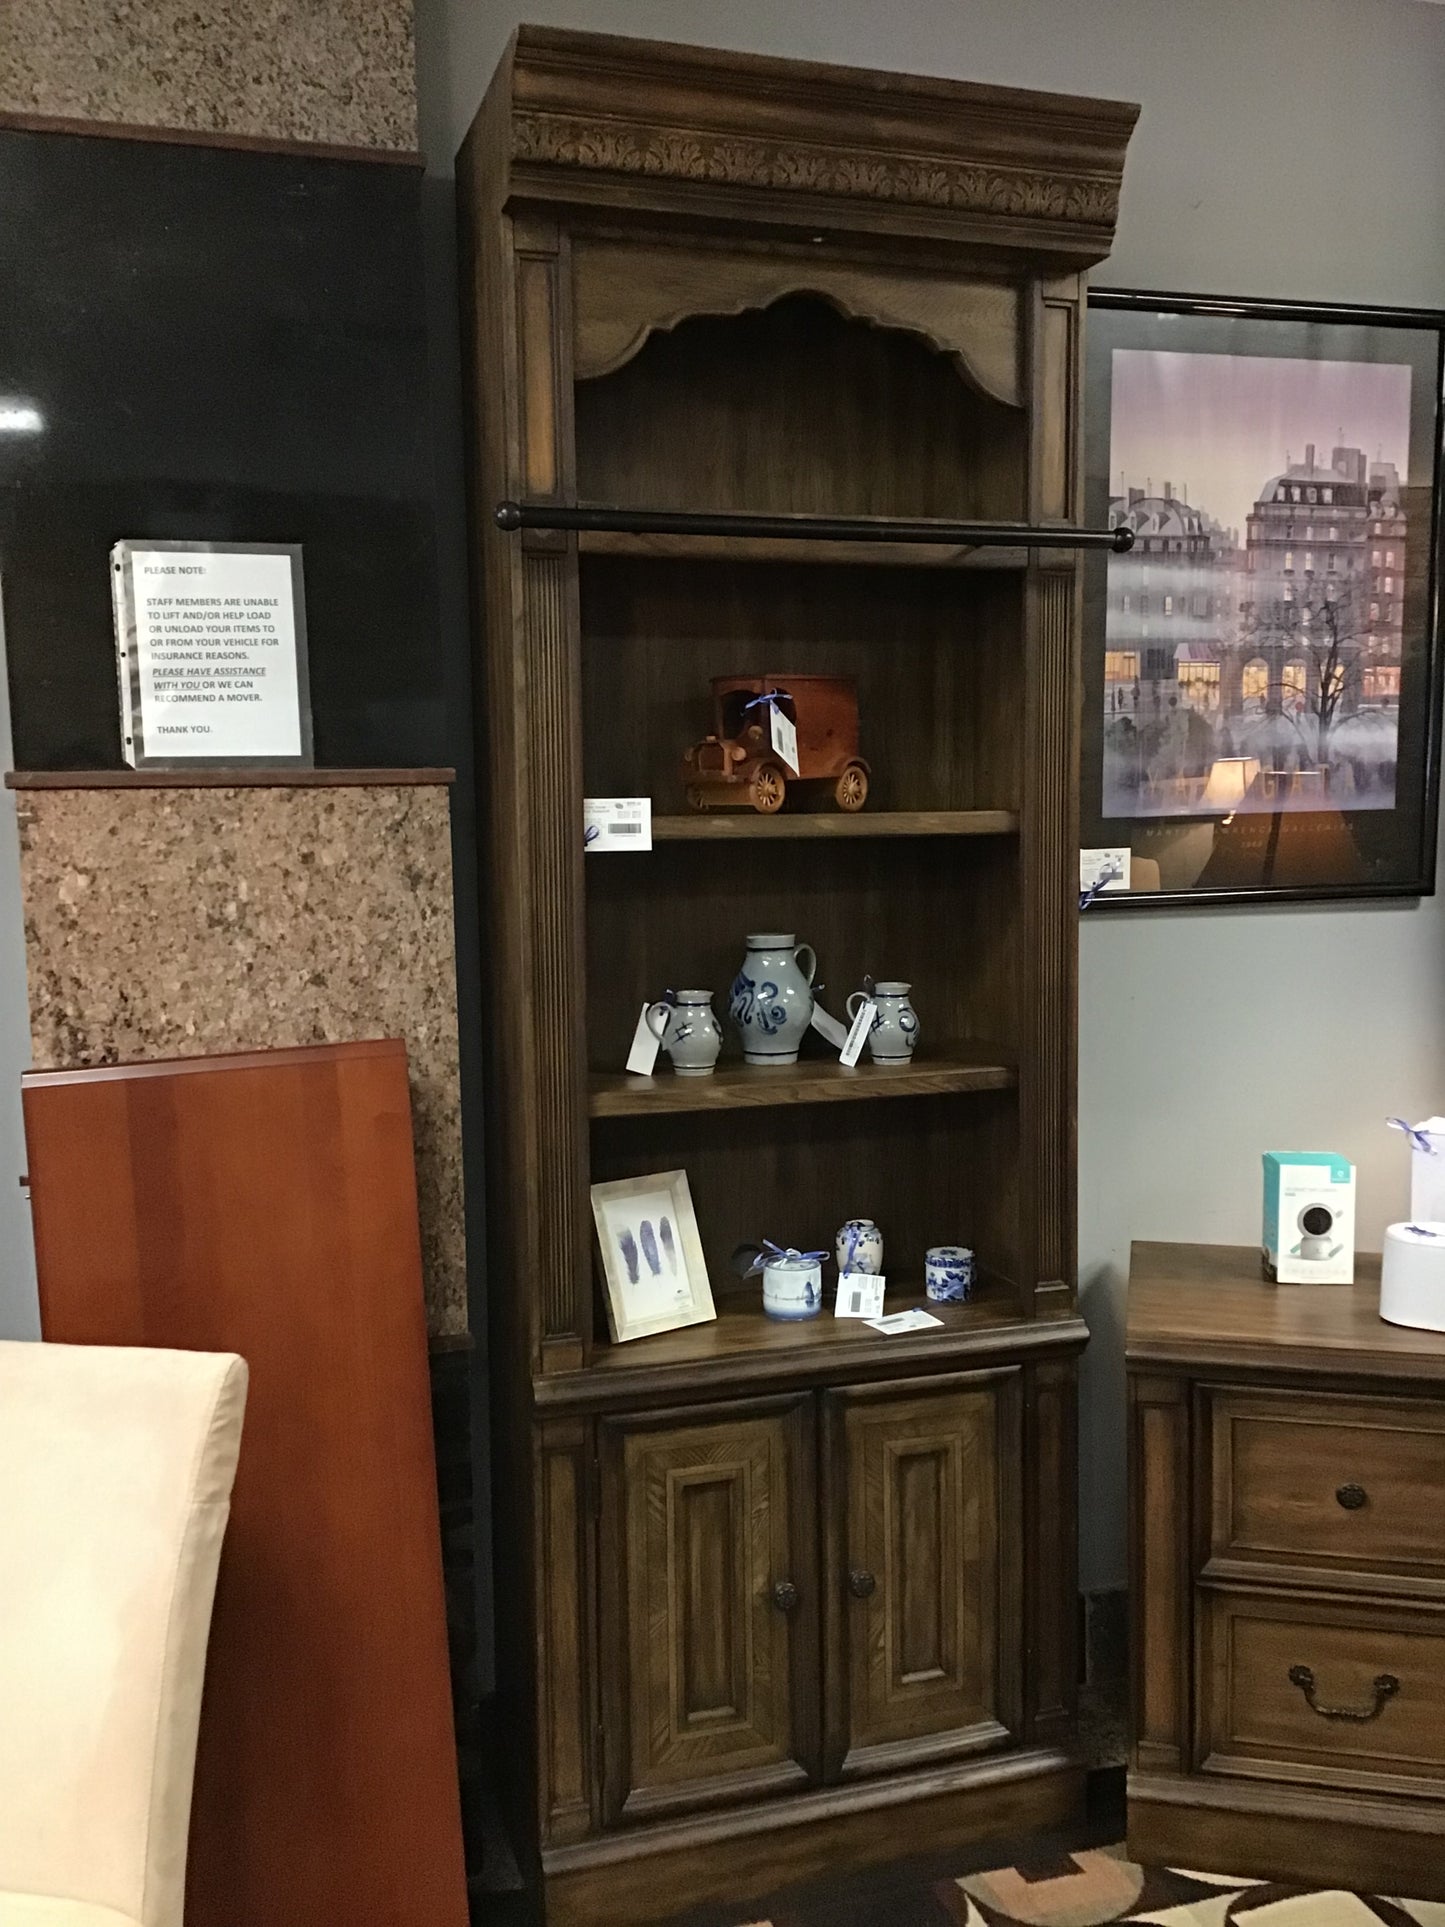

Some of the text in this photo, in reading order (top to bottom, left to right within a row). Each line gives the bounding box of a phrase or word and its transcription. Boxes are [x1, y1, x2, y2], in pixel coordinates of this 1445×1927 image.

[144, 566, 176, 575] PLEASE
[146, 598, 279, 607] STAFF MEMBERS ARE UNABLE
[147, 610, 272, 621] TO LIFT AND/OR HELP LOAD
[149, 625, 275, 633] OR UNLOAD YOUR ITEMS TO
[150, 638, 280, 647] OR FROM YOUR VEHICLE FOR
[151, 651, 250, 660] INSURANCE REASONS.
[152, 667, 267, 677] PLEASE HAVE ASSISTANCE
[153, 680, 254, 690] WITH YOU OR WE CAN
[154, 693, 263, 703] RECOMMEND A MOVER.
[157, 725, 189, 734] THANK
